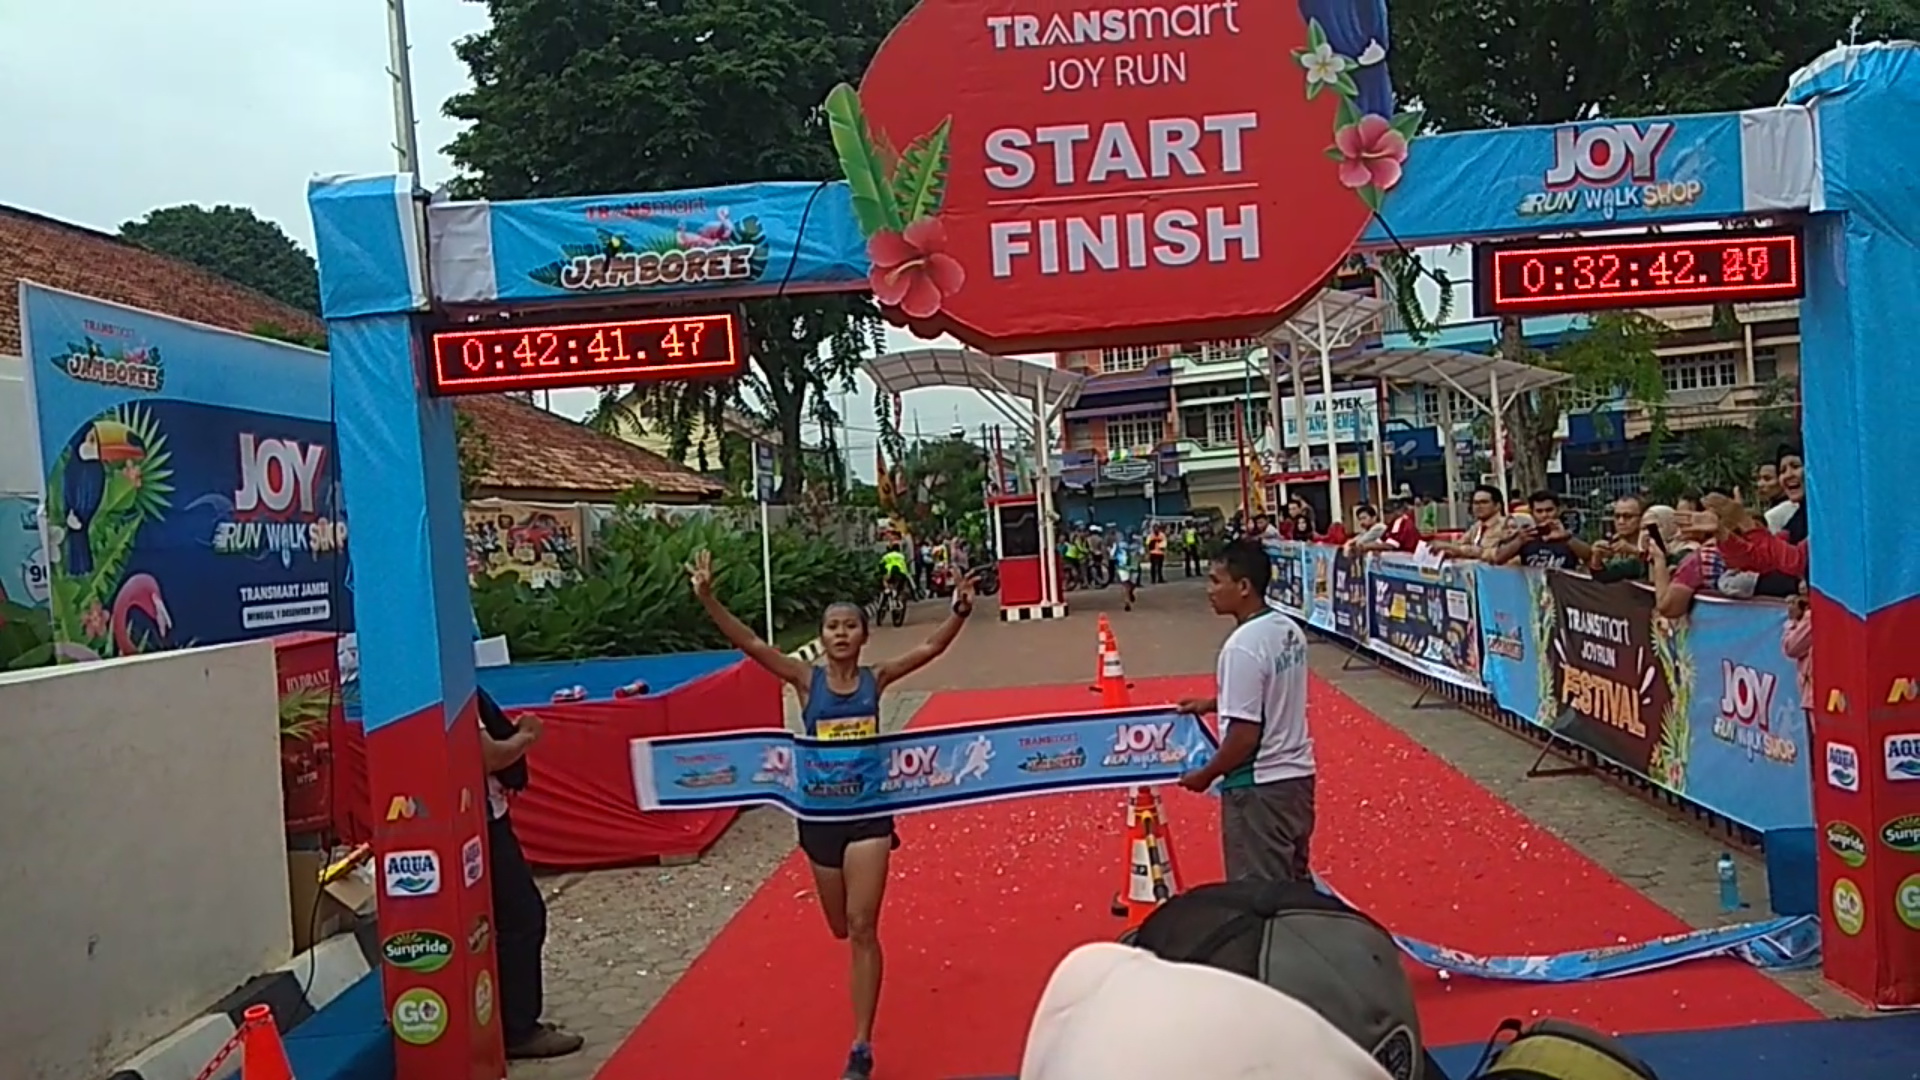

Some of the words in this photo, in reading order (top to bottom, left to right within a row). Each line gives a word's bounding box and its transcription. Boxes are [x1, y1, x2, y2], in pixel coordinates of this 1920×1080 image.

[987, 1, 1240, 48] TRANSmart
[1043, 57, 1105, 91] JOY
[1115, 52, 1187, 86] RUN
[984, 112, 1258, 188] START
[1546, 121, 1672, 187] JOY
[1517, 190, 1578, 215] RUN
[1584, 186, 1639, 219] WALK
[1643, 181, 1702, 207] SHOP
[990, 204, 1260, 277] FINISH
[561, 245, 755, 291] JAMBOREE
[67, 353, 159, 389] JAMBOREE
[1314, 397, 1362, 412] AOTEK
[235, 432, 325, 515] JOY
[212, 522, 262, 553] RUN
[264, 522, 308, 569] WALK
[240, 584, 300, 602] TRANSMART
[301, 581, 329, 598] JAMBI
[1562, 664, 1646, 738] FESTIVAL
[1721, 658, 1776, 731] JOY
[1113, 721, 1173, 754] JOY
[888, 745, 938, 779] JOY
[387, 854, 435, 876] AQUA
[386, 940, 448, 959] Sunpride
[398, 999, 440, 1023] GO
